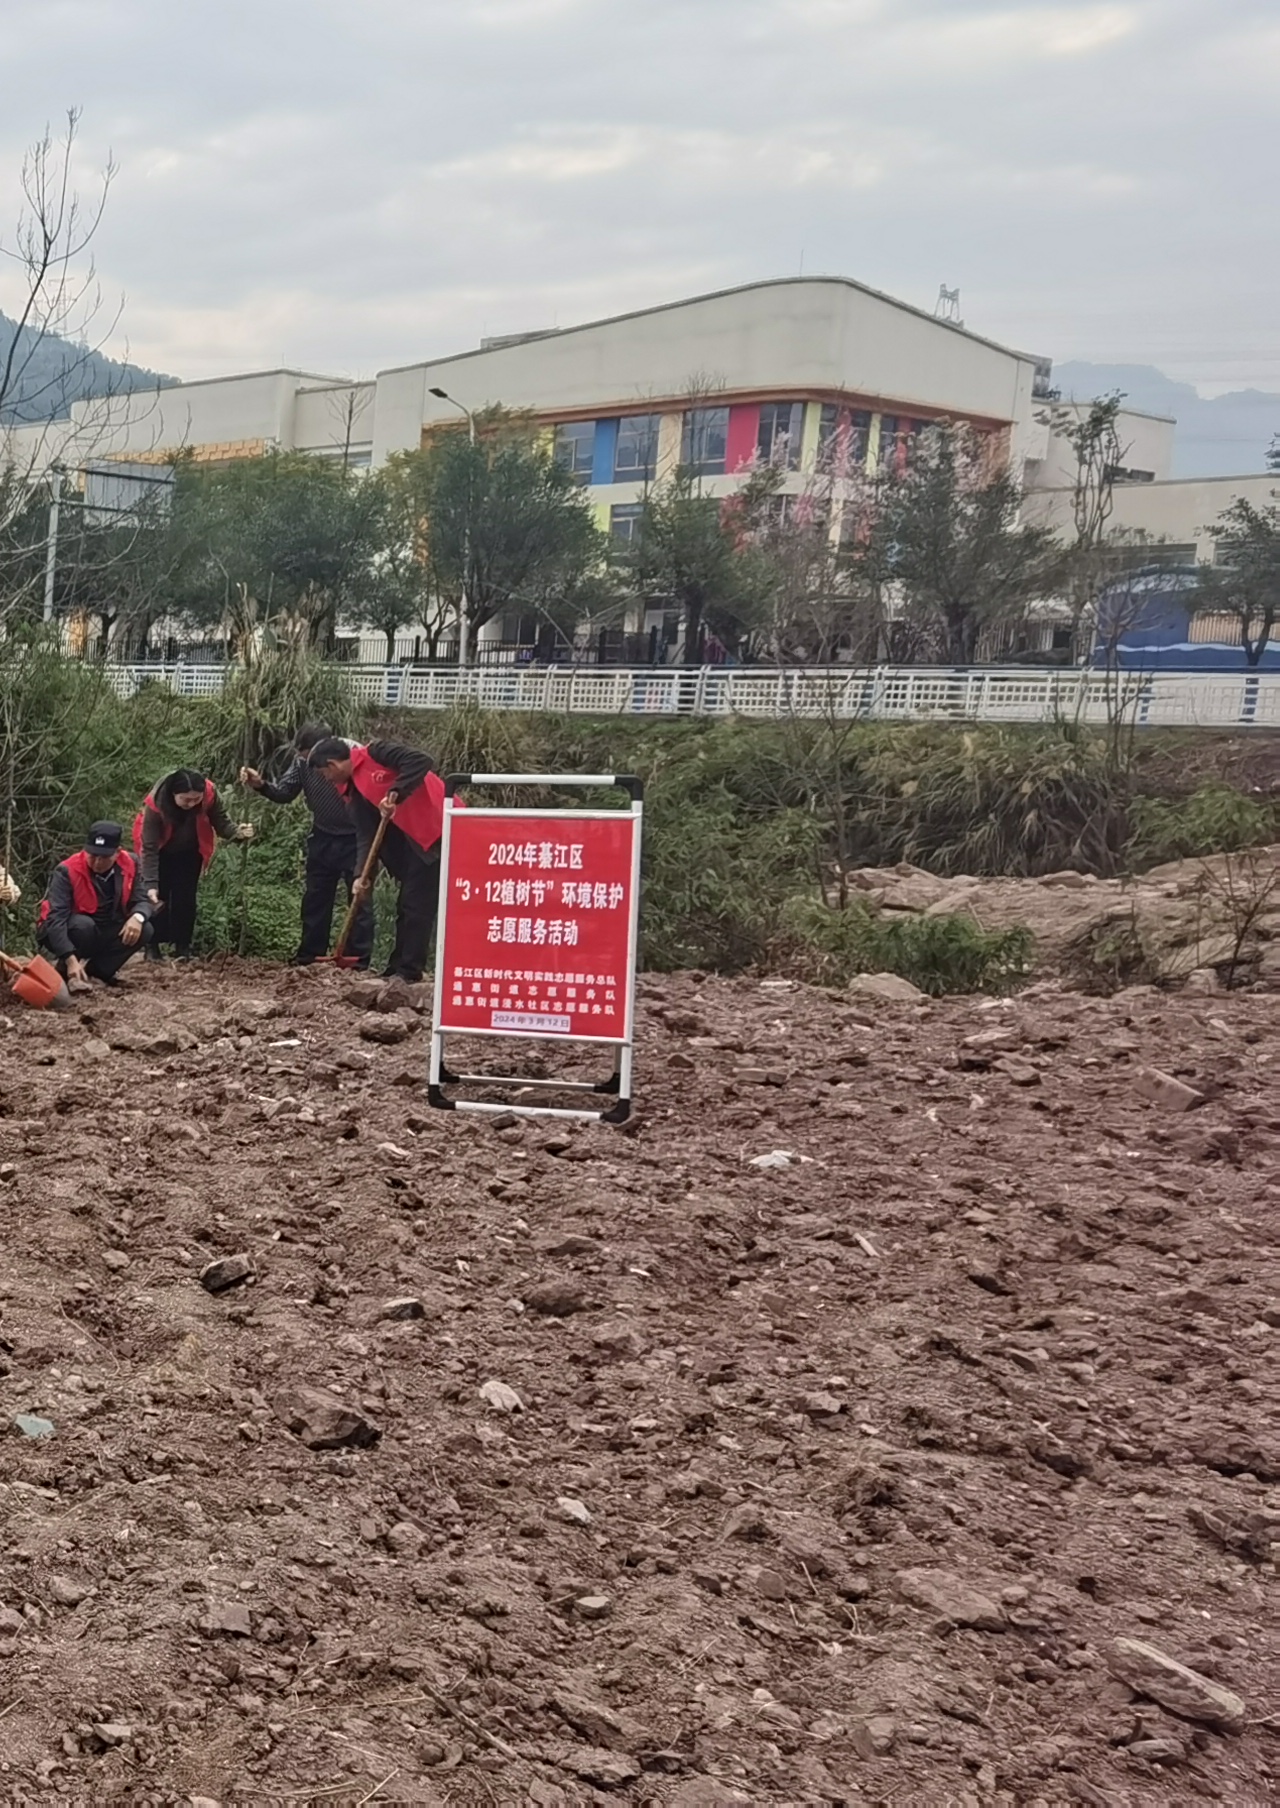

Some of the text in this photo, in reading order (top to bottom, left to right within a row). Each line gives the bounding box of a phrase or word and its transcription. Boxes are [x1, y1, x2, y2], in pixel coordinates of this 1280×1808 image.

[488, 842, 584, 869] 2024年綦江区
[487, 916, 579, 946] 志愿服务活动
